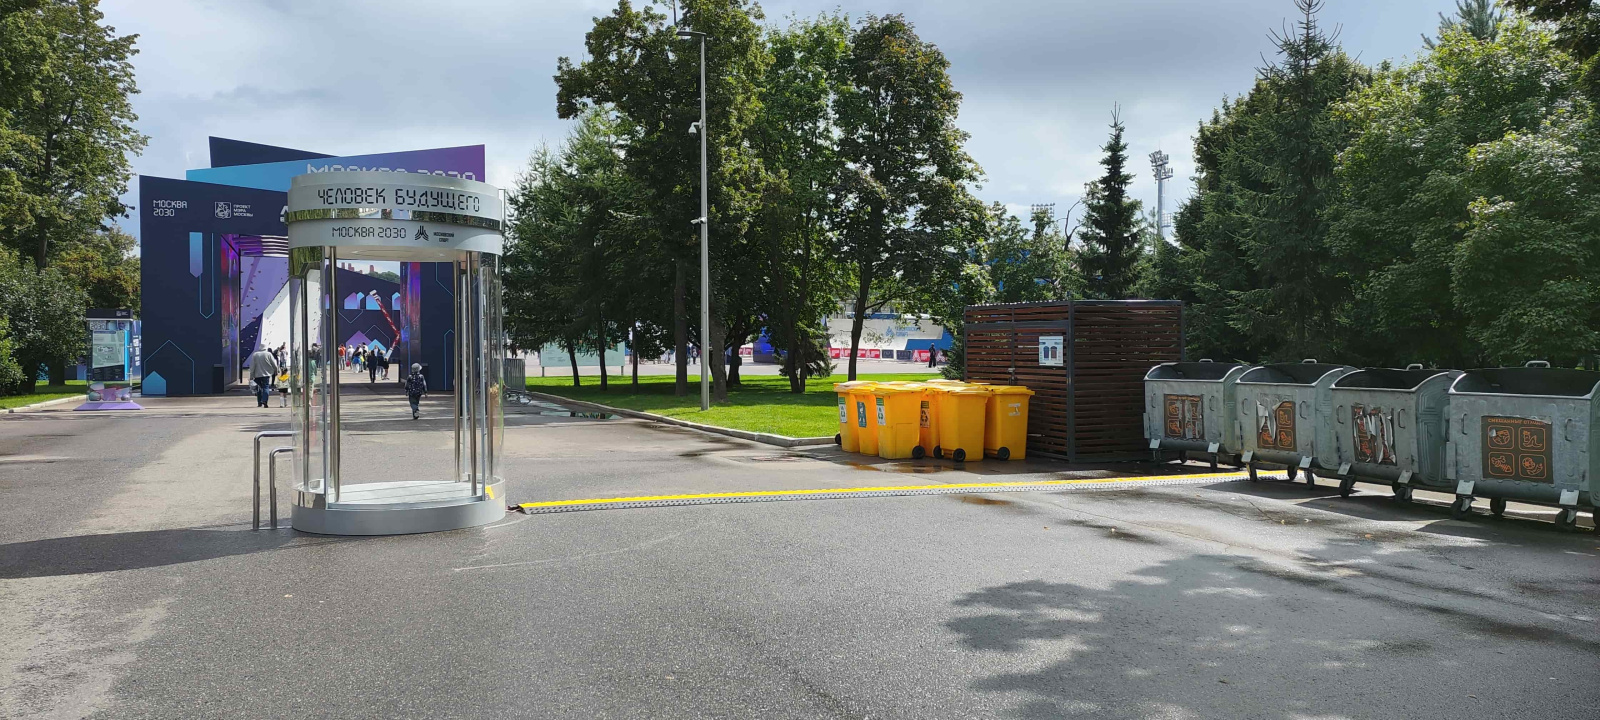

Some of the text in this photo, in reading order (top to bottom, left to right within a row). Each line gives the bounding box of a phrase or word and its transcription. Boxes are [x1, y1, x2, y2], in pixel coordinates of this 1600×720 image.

[153, 200, 187, 208] МОСКВА
[318, 187, 480, 212] ЧЕЛОВЕК БУДУЩЕГО
[153, 208, 174, 216] 2030
[332, 226, 406, 239] МОСКВА 2030
